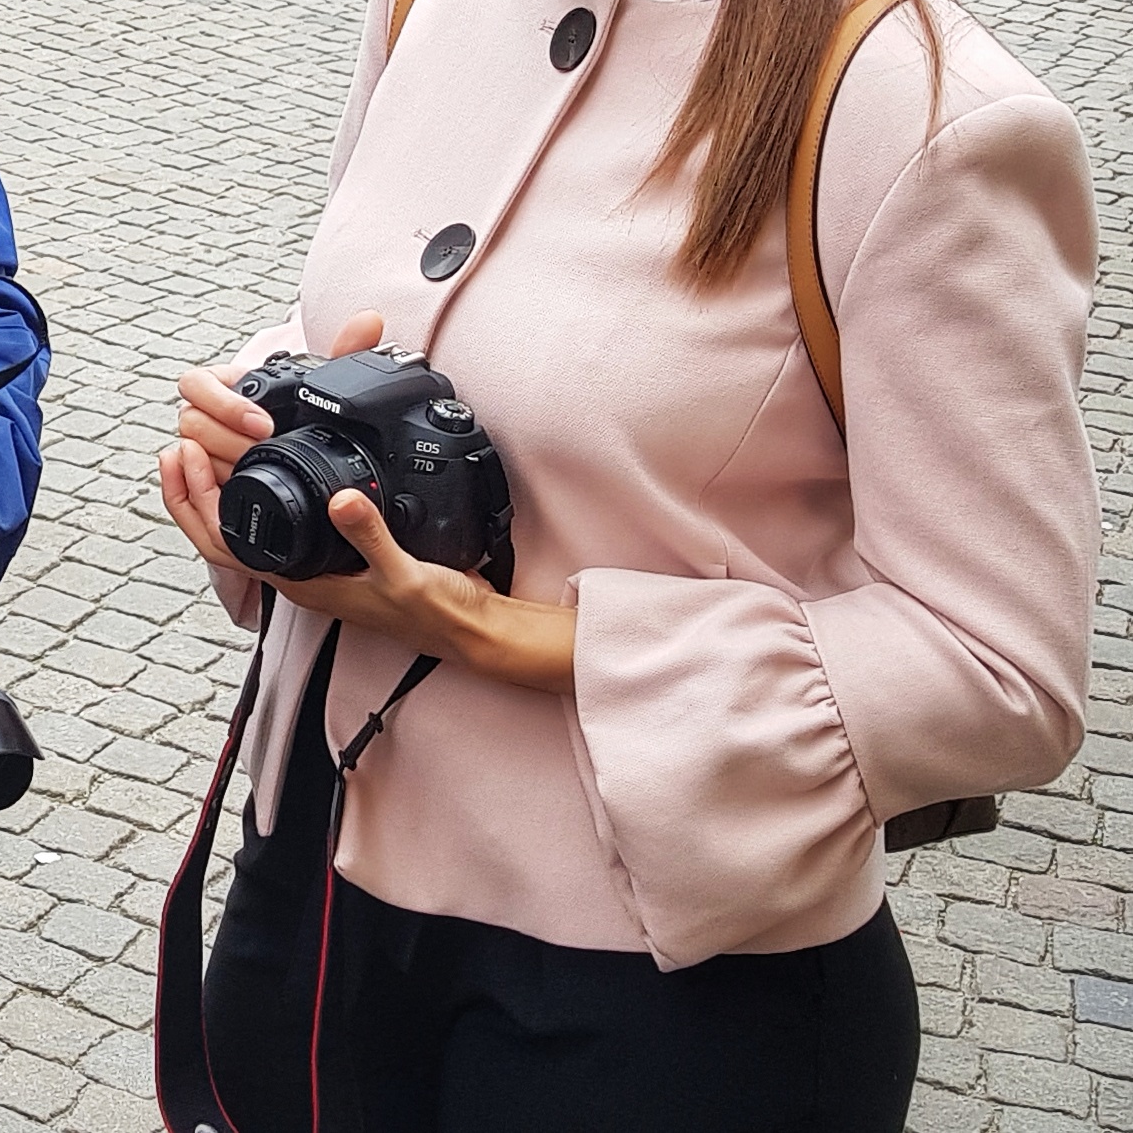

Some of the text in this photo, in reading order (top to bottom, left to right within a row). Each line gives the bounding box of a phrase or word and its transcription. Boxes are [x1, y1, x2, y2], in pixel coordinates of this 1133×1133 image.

[298, 387, 341, 414] Canon
[415, 441, 442, 454] EOS
[413, 458, 434, 472] 77D
[248, 503, 262, 545] Canon
